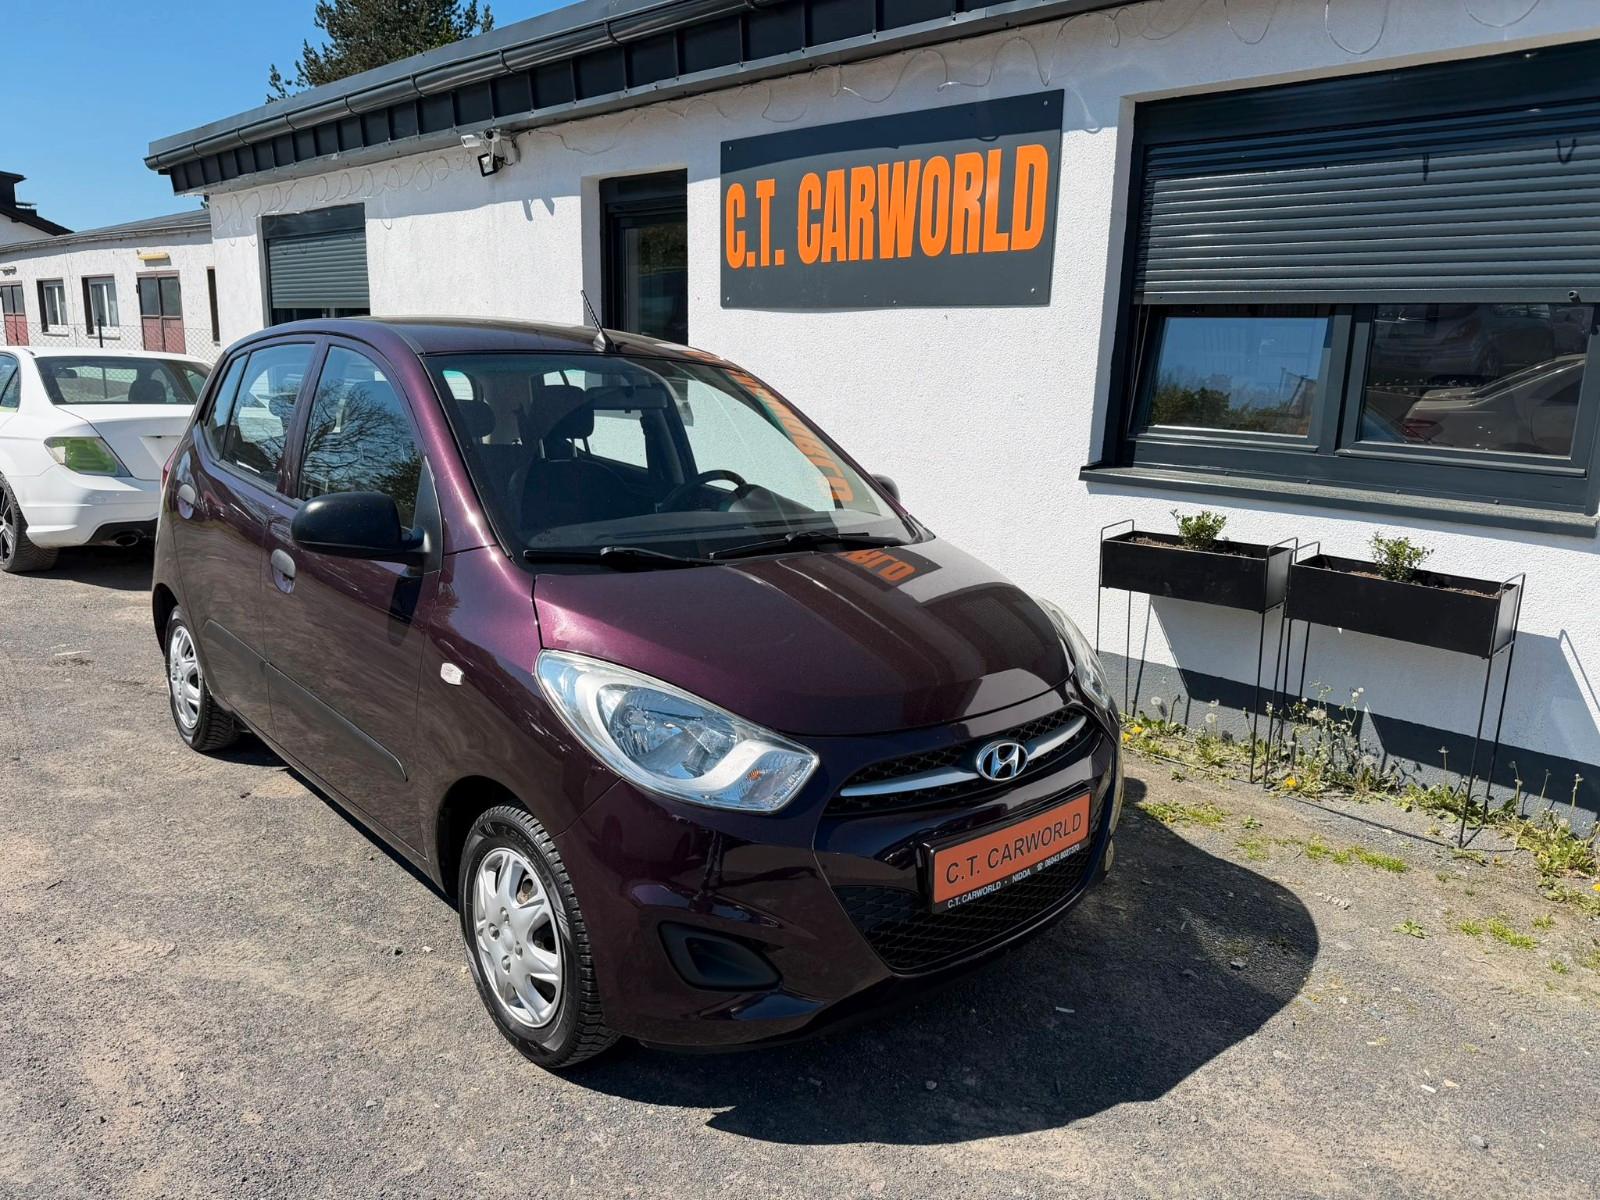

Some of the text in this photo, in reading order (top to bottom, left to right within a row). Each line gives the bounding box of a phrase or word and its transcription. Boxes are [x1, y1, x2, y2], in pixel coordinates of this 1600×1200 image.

[726, 144, 1049, 269] C.T. CARWORLD
[946, 813, 1081, 883] C.T. CARWORLD
[947, 899, 962, 908] C.T.
[962, 881, 1001, 901] CARWORLD
[1012, 869, 1031, 883] NIDDA
